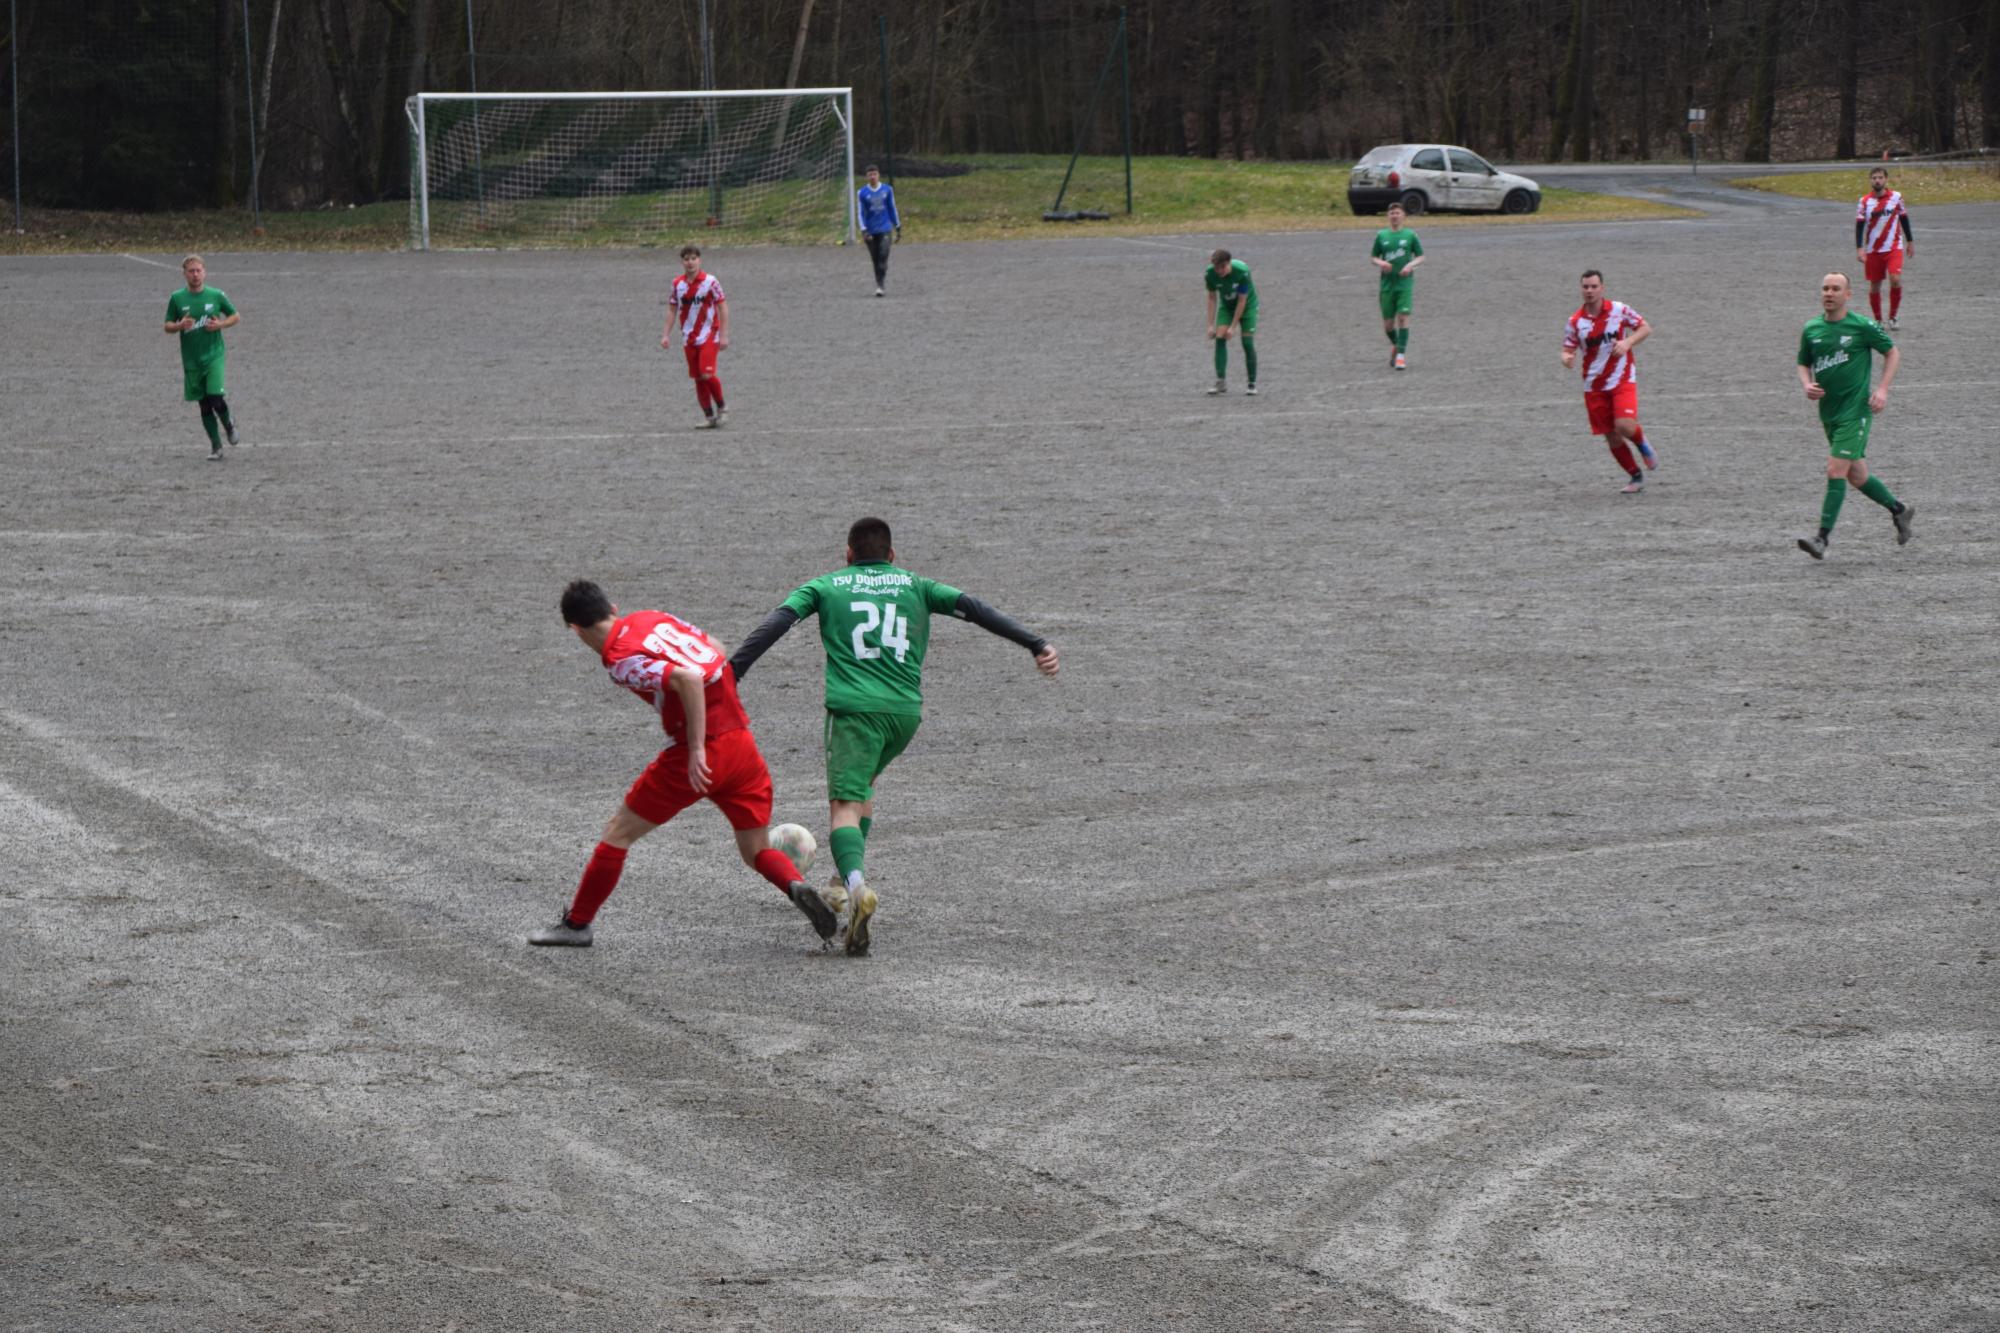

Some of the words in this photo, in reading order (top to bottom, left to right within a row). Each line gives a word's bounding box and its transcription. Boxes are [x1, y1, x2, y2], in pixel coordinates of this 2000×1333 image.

[832, 574, 852, 587] TSV
[642, 622, 719, 677] 78
[850, 601, 910, 663] 24
